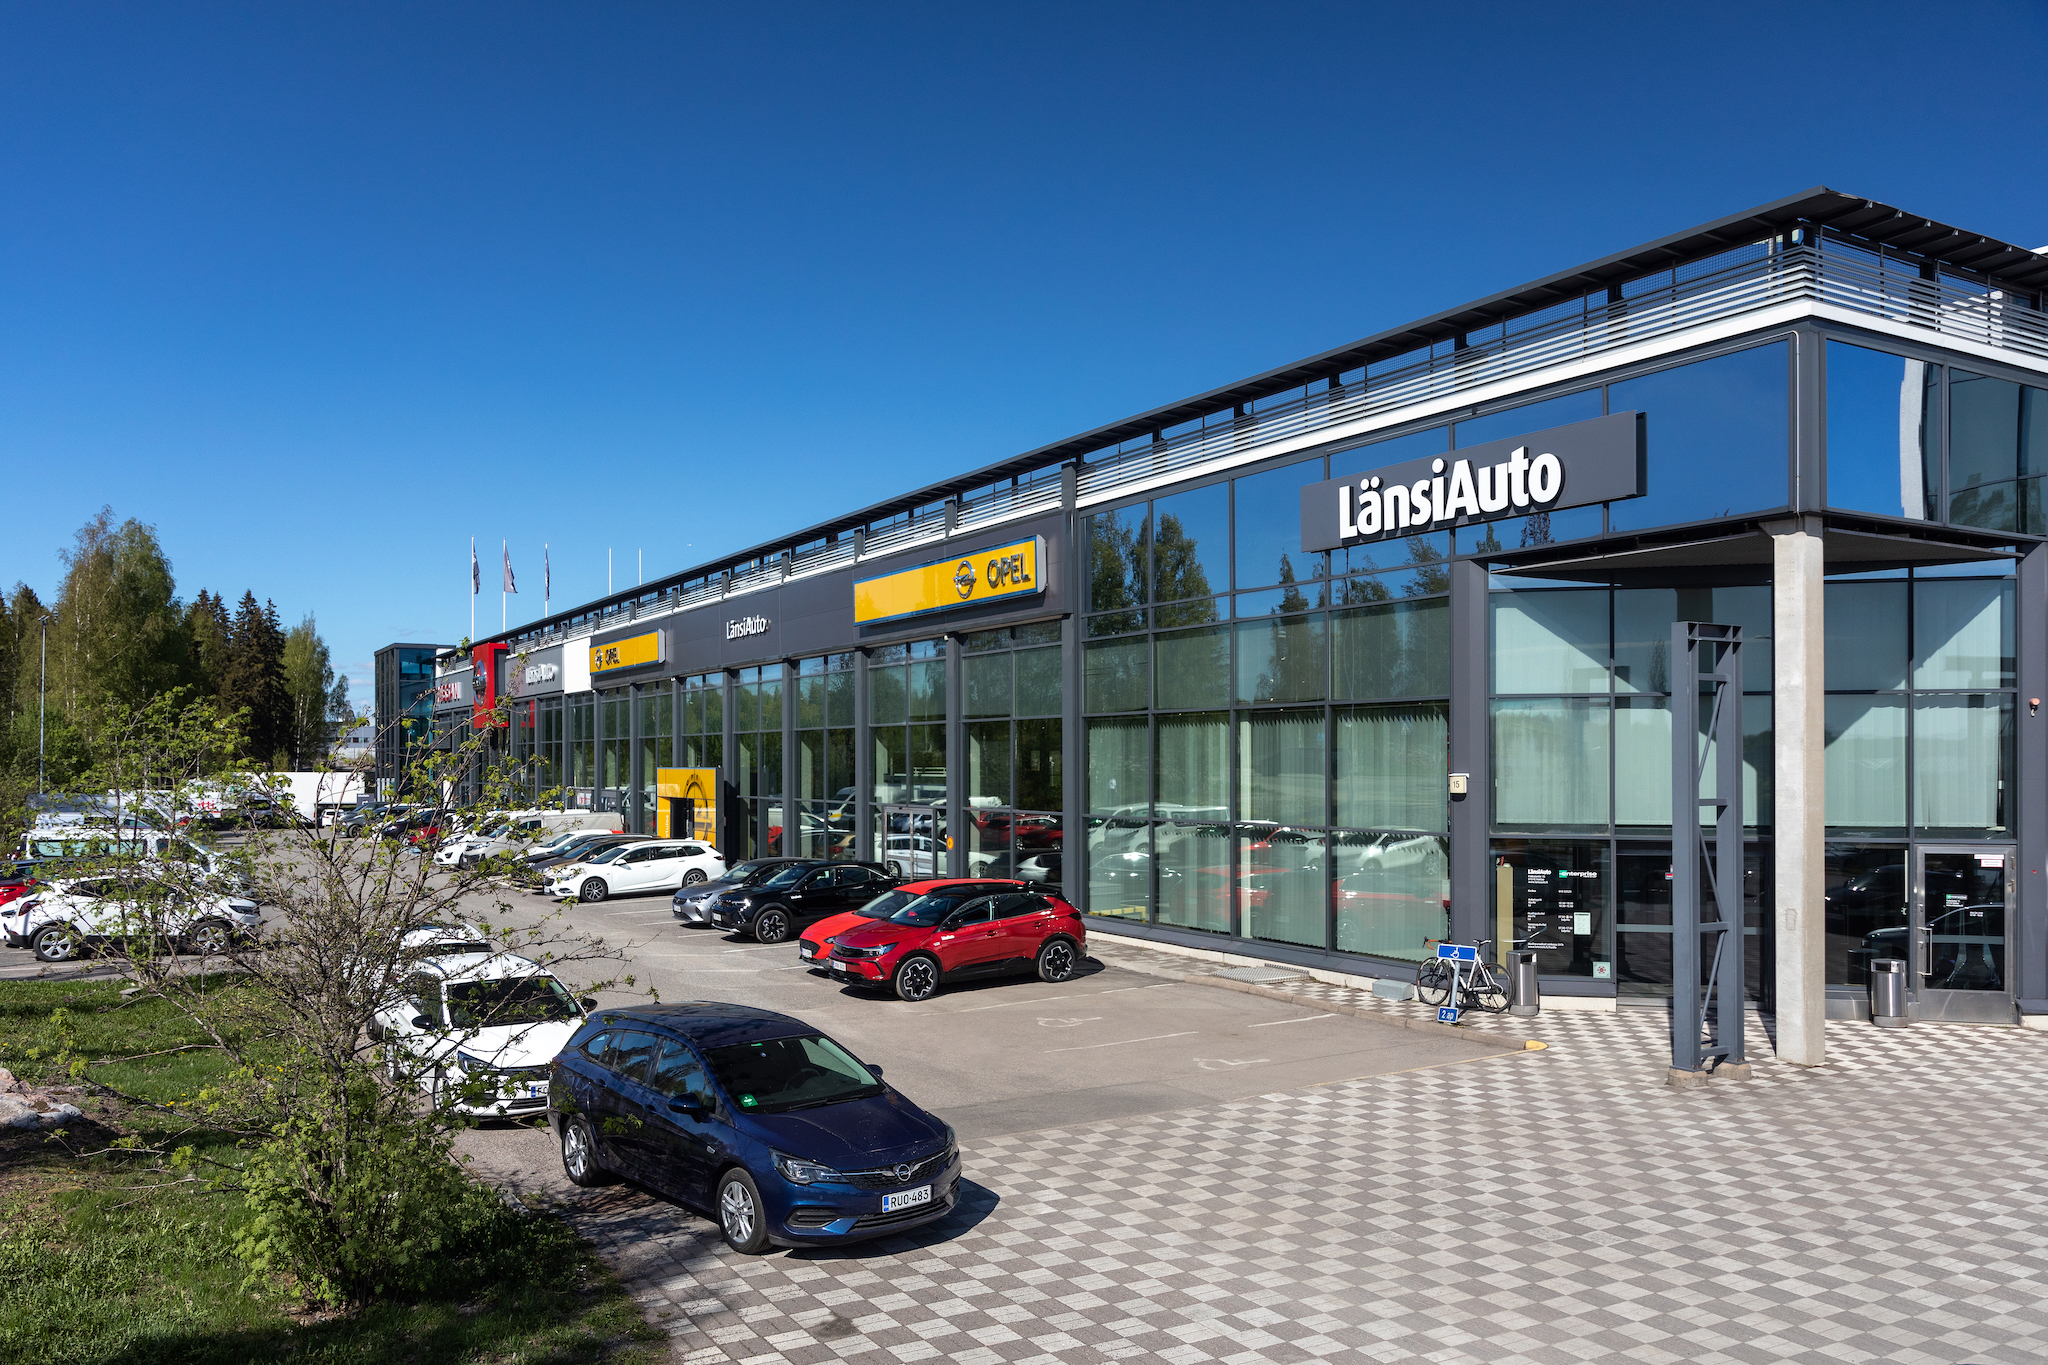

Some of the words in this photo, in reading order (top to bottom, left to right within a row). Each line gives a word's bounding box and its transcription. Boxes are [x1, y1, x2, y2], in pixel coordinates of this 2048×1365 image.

[1339, 445, 1563, 540] LänsiAuto
[986, 552, 1031, 589] OPEL
[725, 616, 769, 640] LänsiAuto
[604, 647, 621, 666] OPEL
[1452, 780, 1460, 789] 15
[1441, 1009, 1447, 1019] 2
[1446, 1011, 1454, 1021] ap
